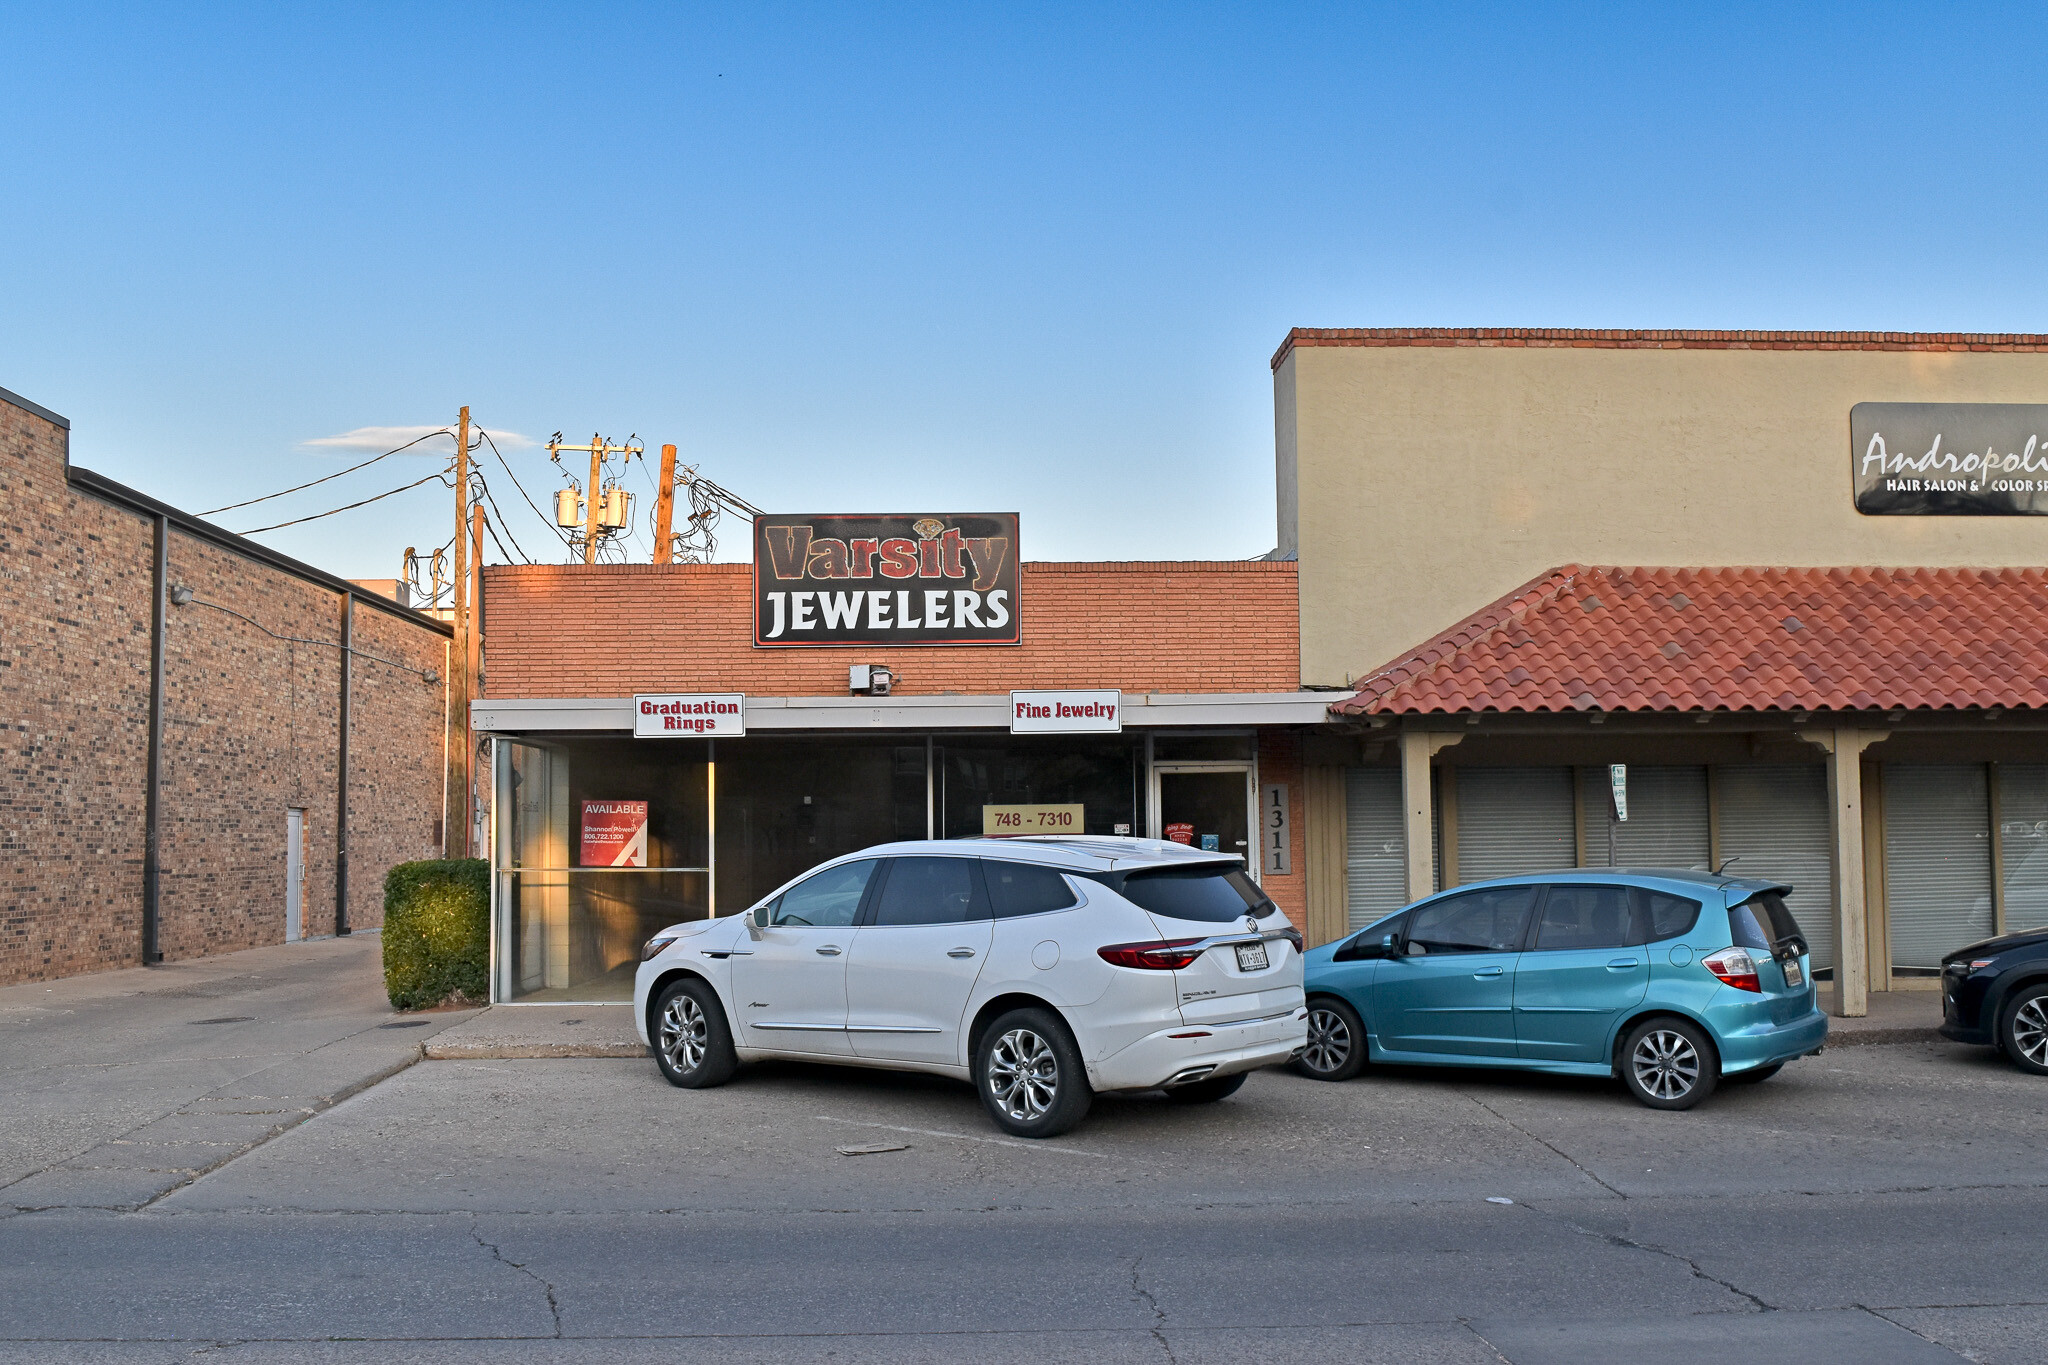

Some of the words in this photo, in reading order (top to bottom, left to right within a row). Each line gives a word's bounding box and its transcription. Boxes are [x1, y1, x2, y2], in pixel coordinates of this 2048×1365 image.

[1886, 479, 1921, 492] HAIR
[1924, 479, 1967, 492] SALON
[1970, 479, 1979, 492] &
[1991, 479, 2034, 492] COLOR
[765, 525, 1008, 591] Varsity
[765, 589, 1010, 638] JEWELERS
[640, 700, 739, 715] Graduation
[1016, 702, 1051, 718] Fine
[1055, 701, 1116, 721] Jewelry
[663, 716, 716, 733] Rings
[584, 804, 645, 814] AVAILABLE
[994, 812, 1022, 827] 748
[1037, 812, 1073, 826] 7310
[584, 825, 613, 833] Shannon
[614, 825, 636, 833] Powell
[1270, 789, 1284, 870] 1311
